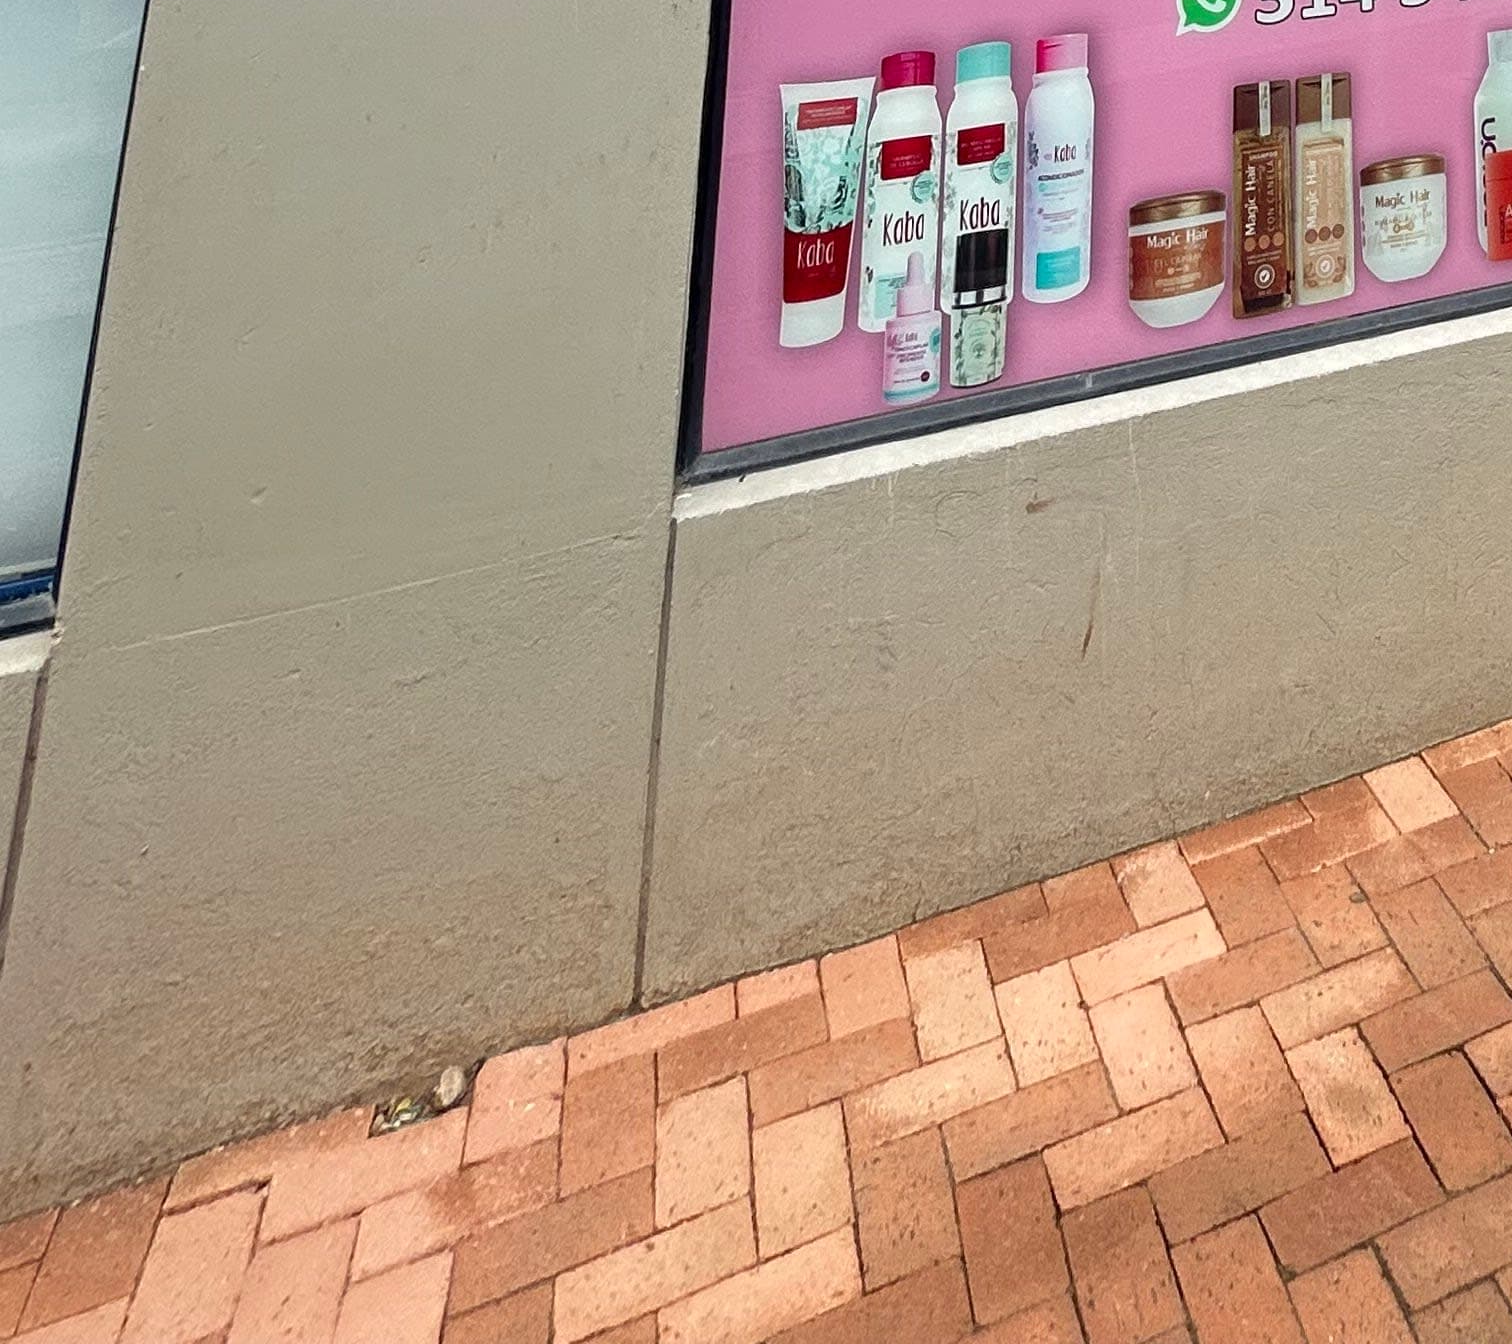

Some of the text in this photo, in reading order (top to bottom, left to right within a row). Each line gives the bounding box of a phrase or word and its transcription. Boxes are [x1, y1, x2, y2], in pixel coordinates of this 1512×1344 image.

[1053, 143, 1078, 164] Kaba
[959, 196, 1001, 232] Kaba
[1244, 164, 1260, 237] Magic Hair
[1374, 188, 1431, 214] Magic Hair
[882, 210, 926, 248] Kaba
[1146, 227, 1209, 250] Magic Hair
[796, 239, 836, 269] Kaba
